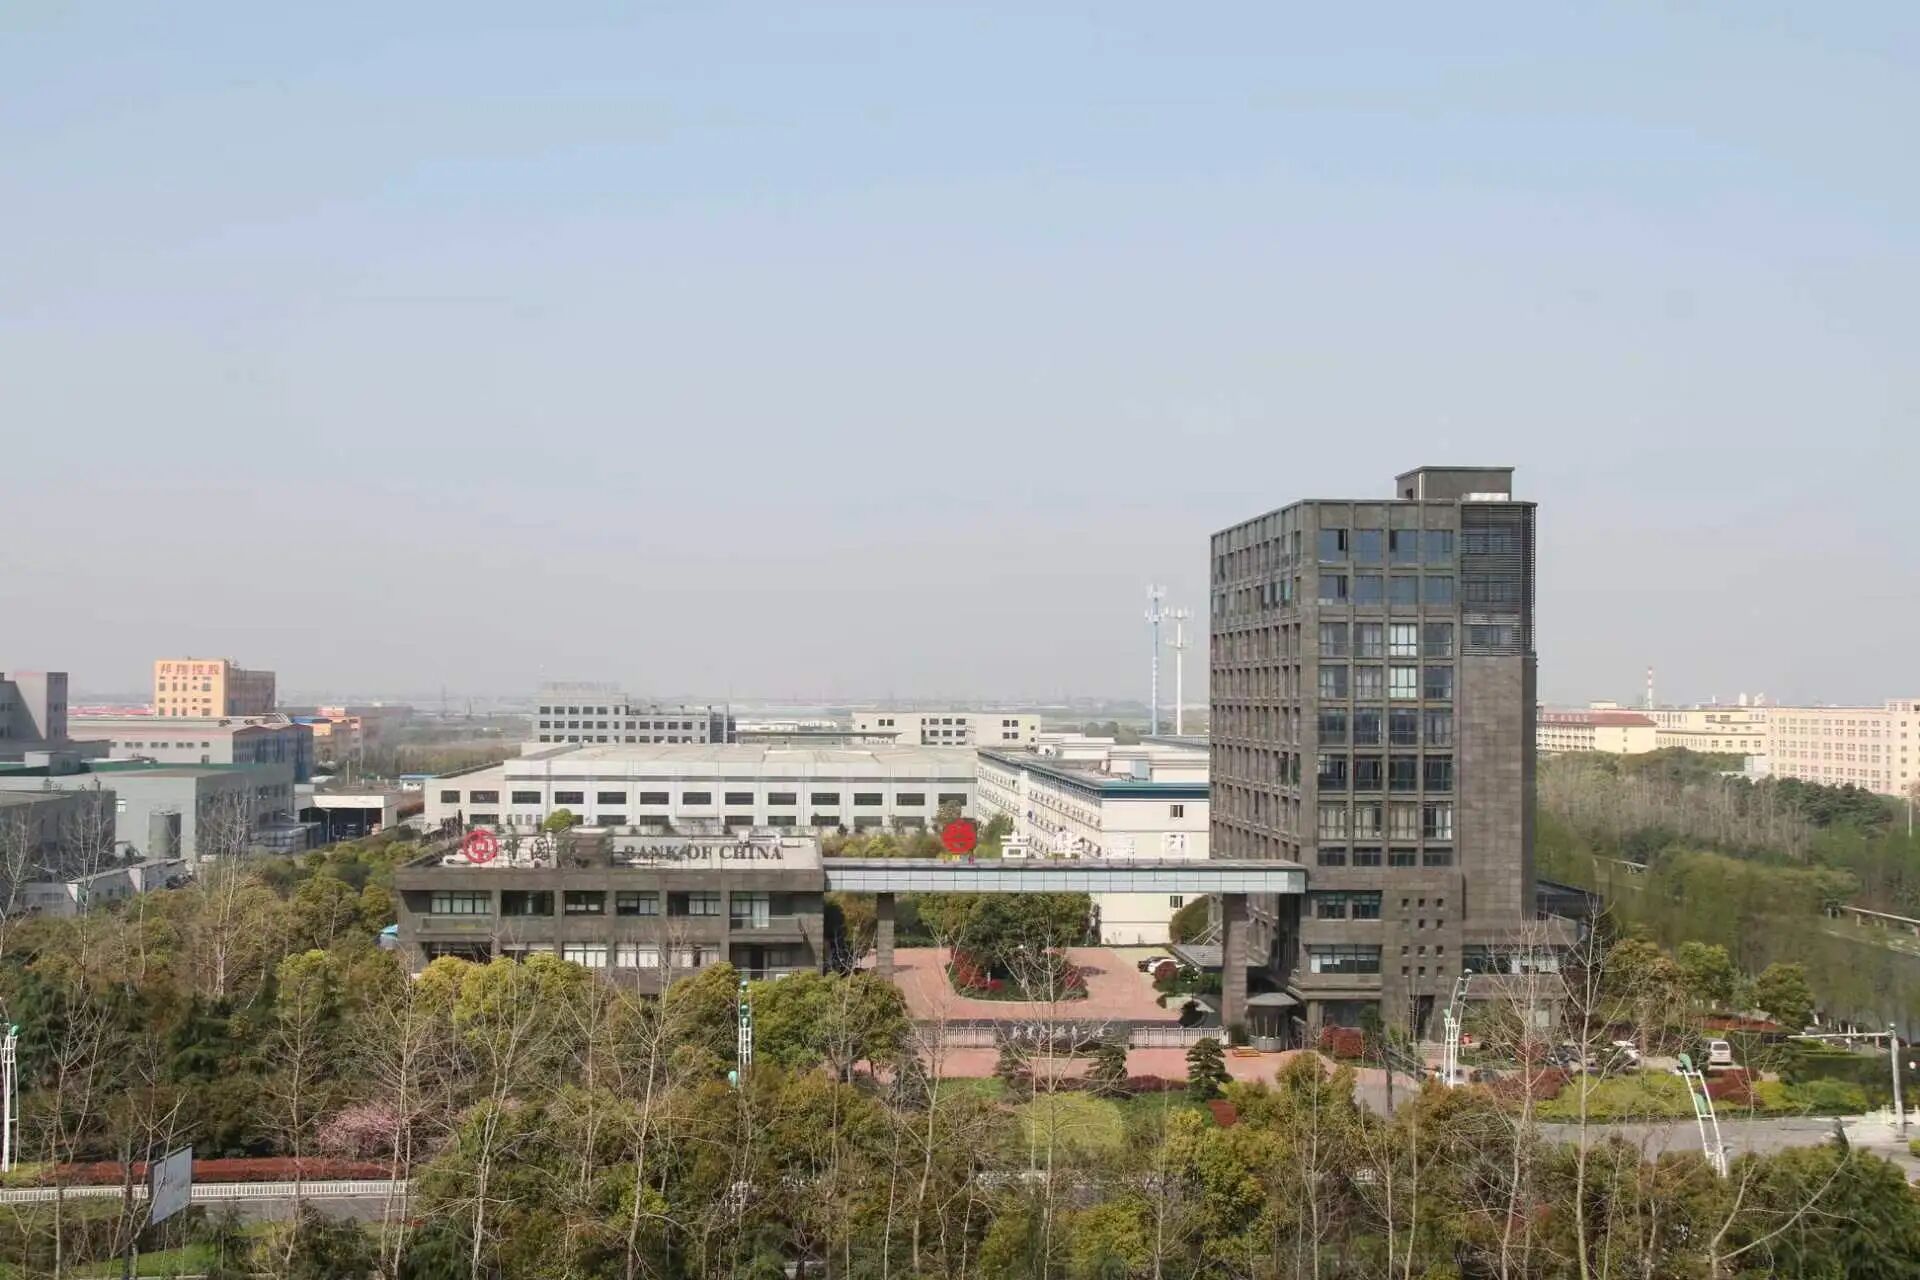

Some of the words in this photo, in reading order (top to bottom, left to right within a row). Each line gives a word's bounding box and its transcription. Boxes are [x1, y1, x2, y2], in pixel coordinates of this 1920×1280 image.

[623, 844, 683, 861] BANK
[687, 844, 713, 860] OF
[719, 844, 784, 860] CHINA
